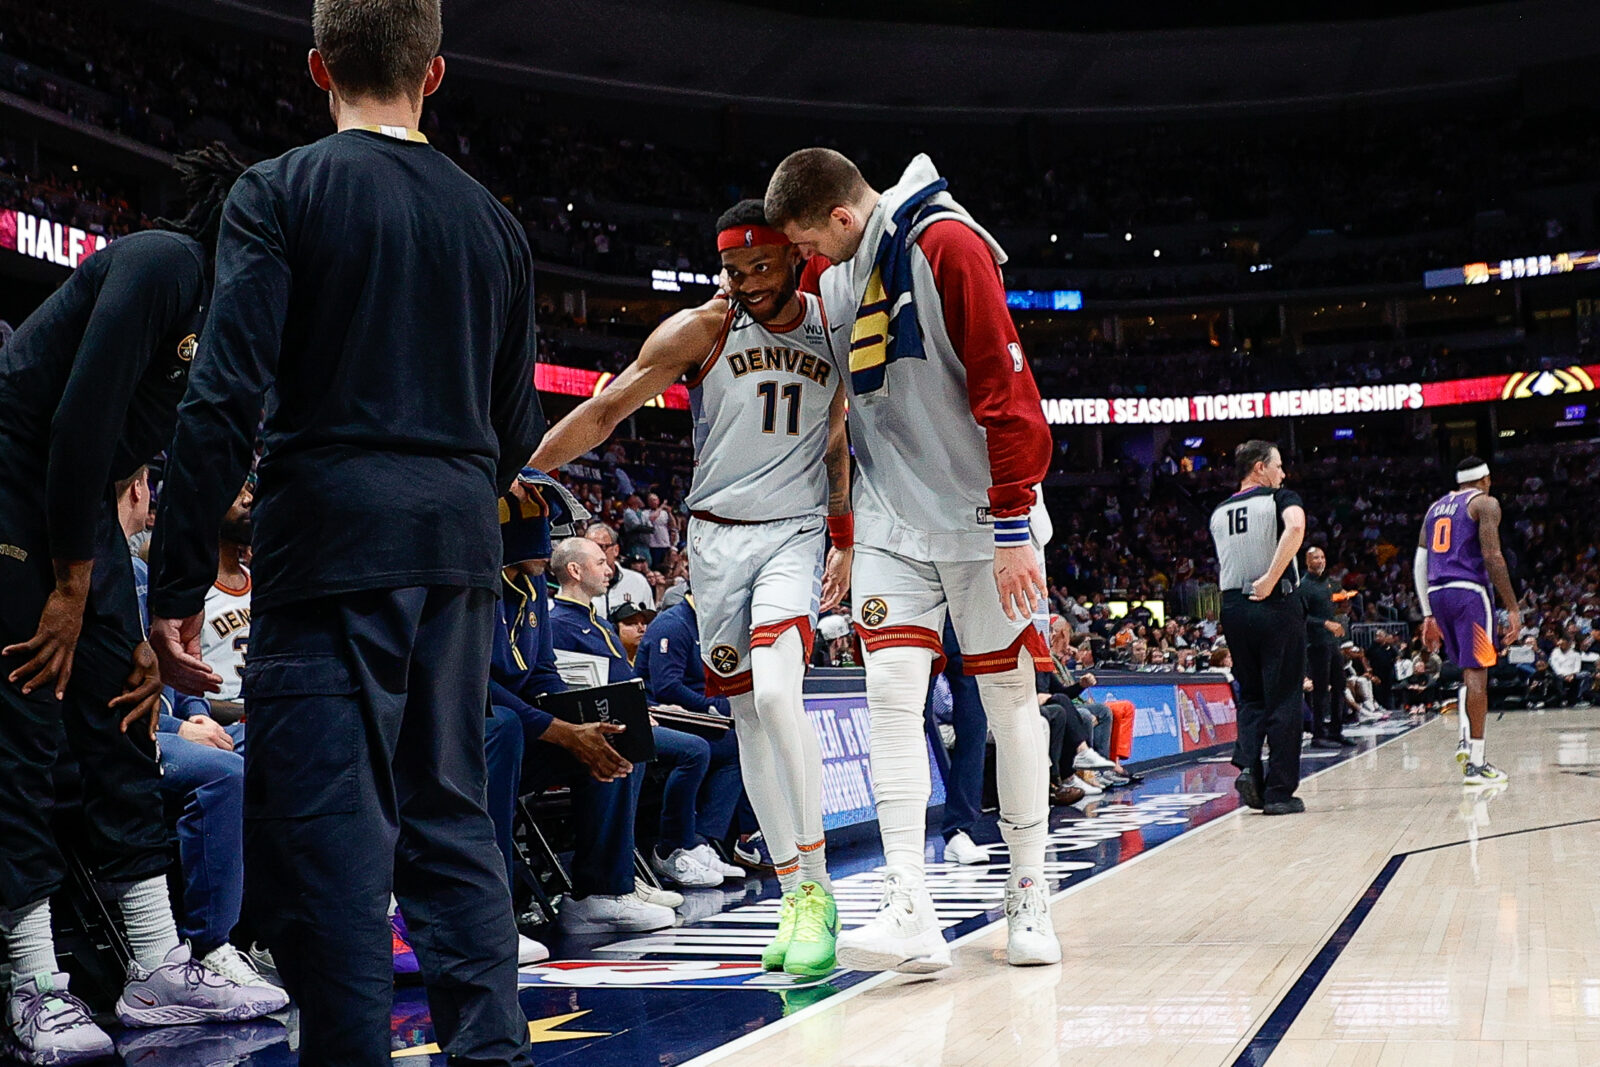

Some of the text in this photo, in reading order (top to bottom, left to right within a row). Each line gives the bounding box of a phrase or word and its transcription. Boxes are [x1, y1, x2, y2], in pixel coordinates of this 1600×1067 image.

[17, 211, 85, 269] HALF
[803, 324, 823, 335] WU
[726, 346, 832, 388] DENVER
[757, 380, 803, 436] 11
[1041, 382, 1424, 424] ARTER SEASON TICKET MEMBERSHIPS
[1226, 506, 1248, 537] 16
[1432, 517, 1452, 553] 0
[208, 607, 251, 640] DEN
